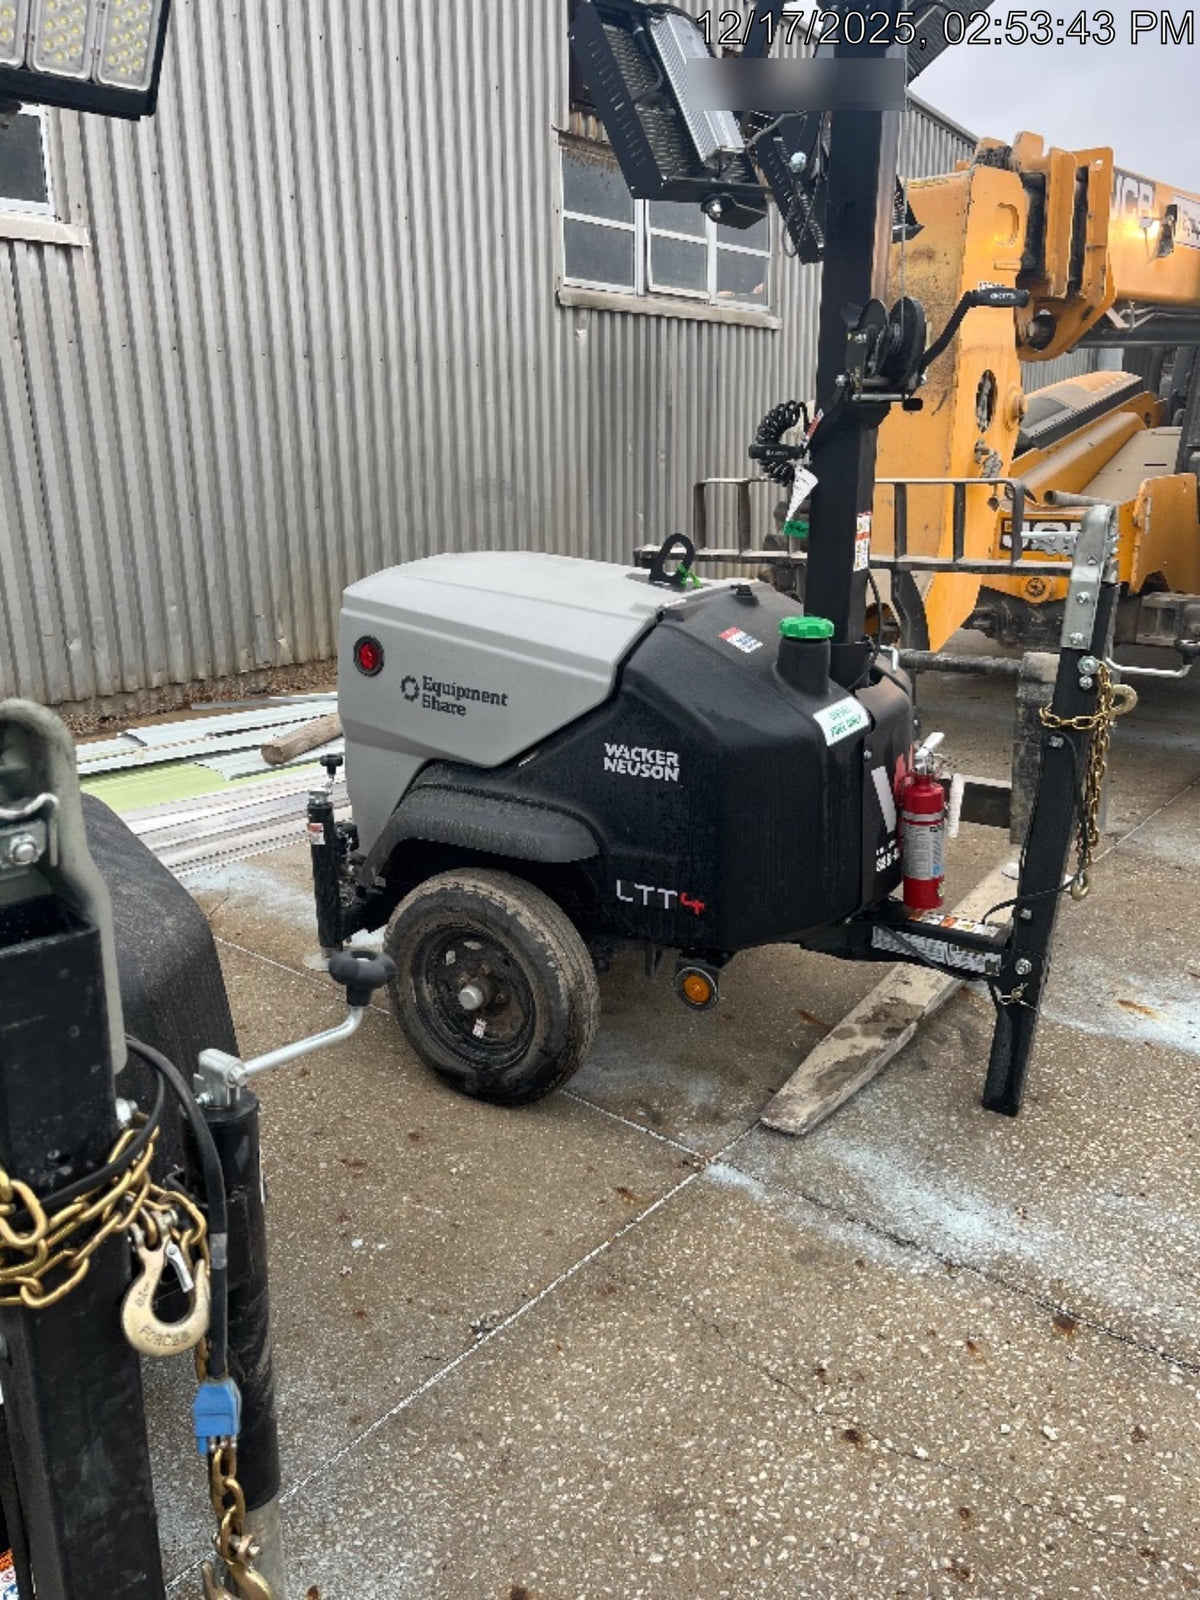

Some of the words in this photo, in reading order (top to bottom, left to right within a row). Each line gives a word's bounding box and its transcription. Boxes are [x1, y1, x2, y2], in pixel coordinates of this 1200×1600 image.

[1110, 173, 1154, 221] JCB
[422, 674, 509, 707] Equipment
[422, 693, 467, 717] Share
[603, 742, 680, 767] WACKER
[603, 756, 680, 783] NEUSON
[616, 879, 706, 916] LTT4
